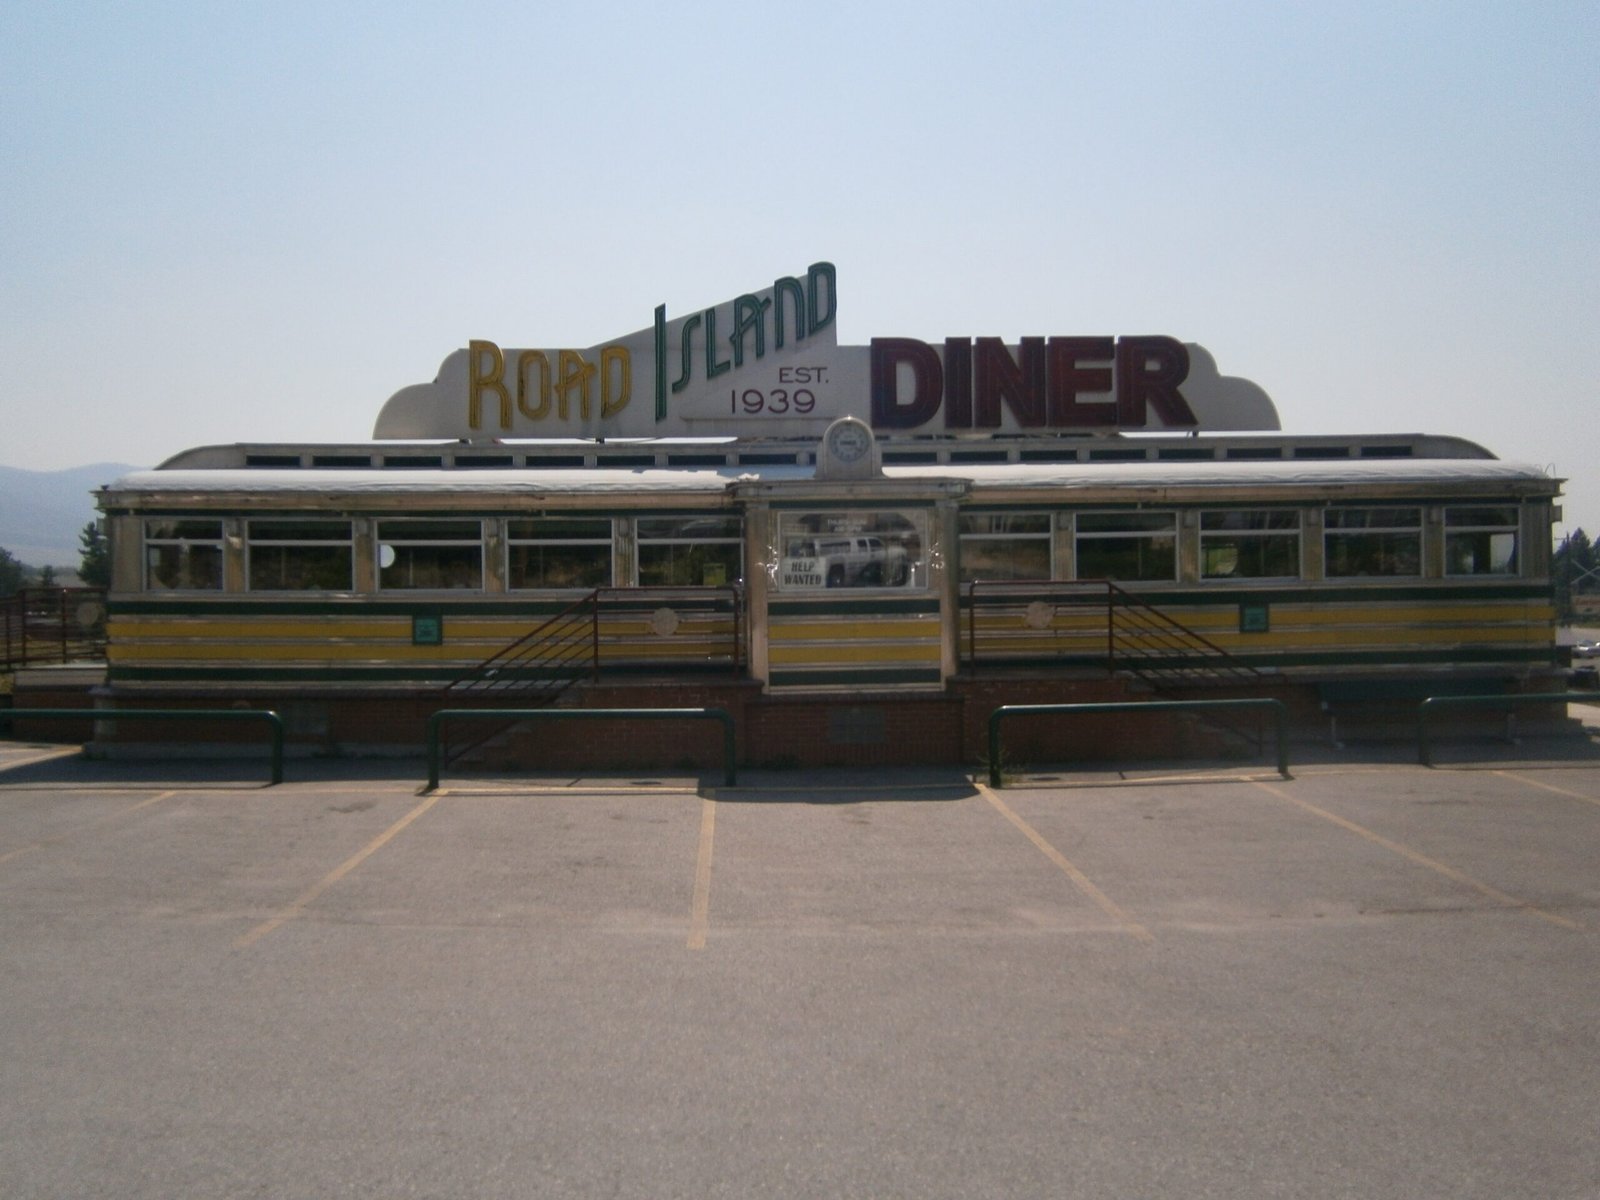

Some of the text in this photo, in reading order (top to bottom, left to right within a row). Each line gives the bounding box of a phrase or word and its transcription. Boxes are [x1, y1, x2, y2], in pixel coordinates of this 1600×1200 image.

[468, 261, 1199, 430] ROAD ISLAND DINER
[778, 366, 829, 384] EST.
[730, 388, 816, 415] 1939
[791, 561, 815, 572] HELP
[784, 574, 822, 585] WANTED
